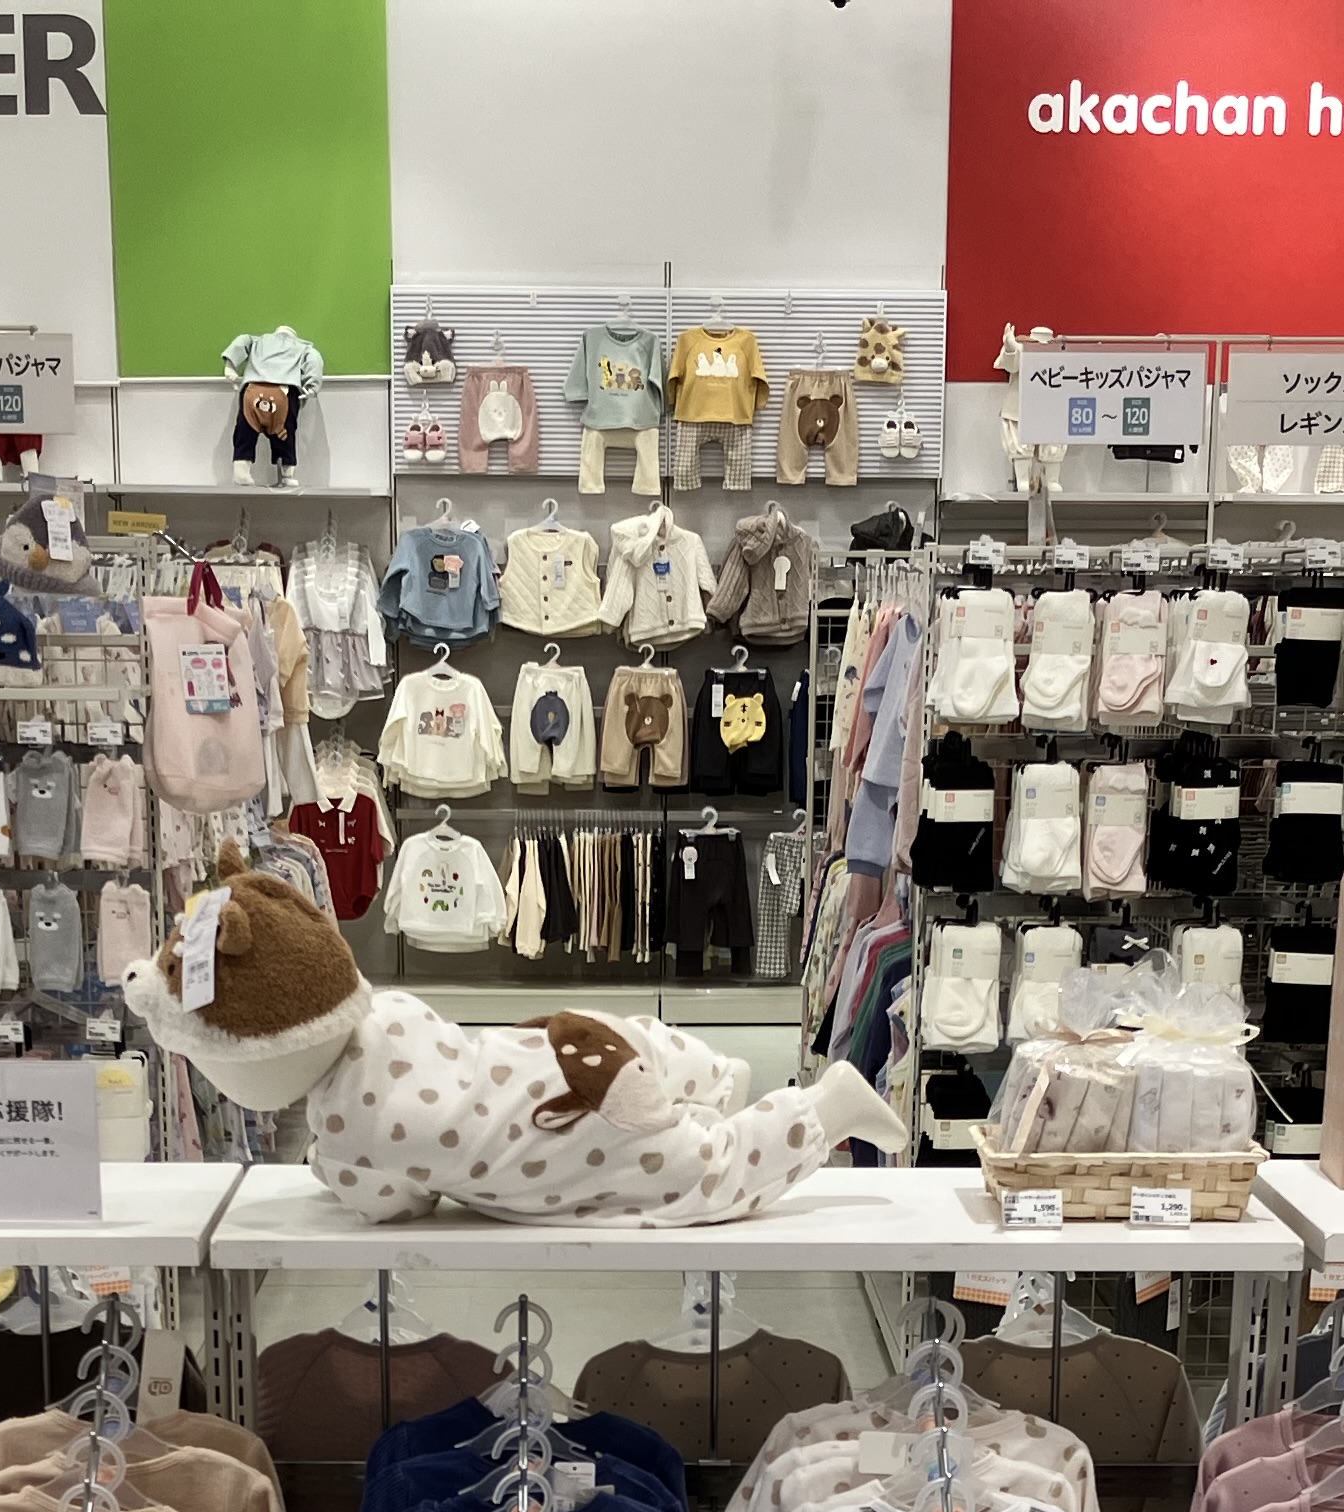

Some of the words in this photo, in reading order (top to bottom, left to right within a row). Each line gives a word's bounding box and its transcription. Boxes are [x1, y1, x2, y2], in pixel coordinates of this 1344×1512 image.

[1028, 80, 1287, 136] akachan
[1030, 366, 1191, 390] ベビーキッズパジャマ
[1071, 408, 1093, 425] 80
[1125, 408, 1148, 425] 120
